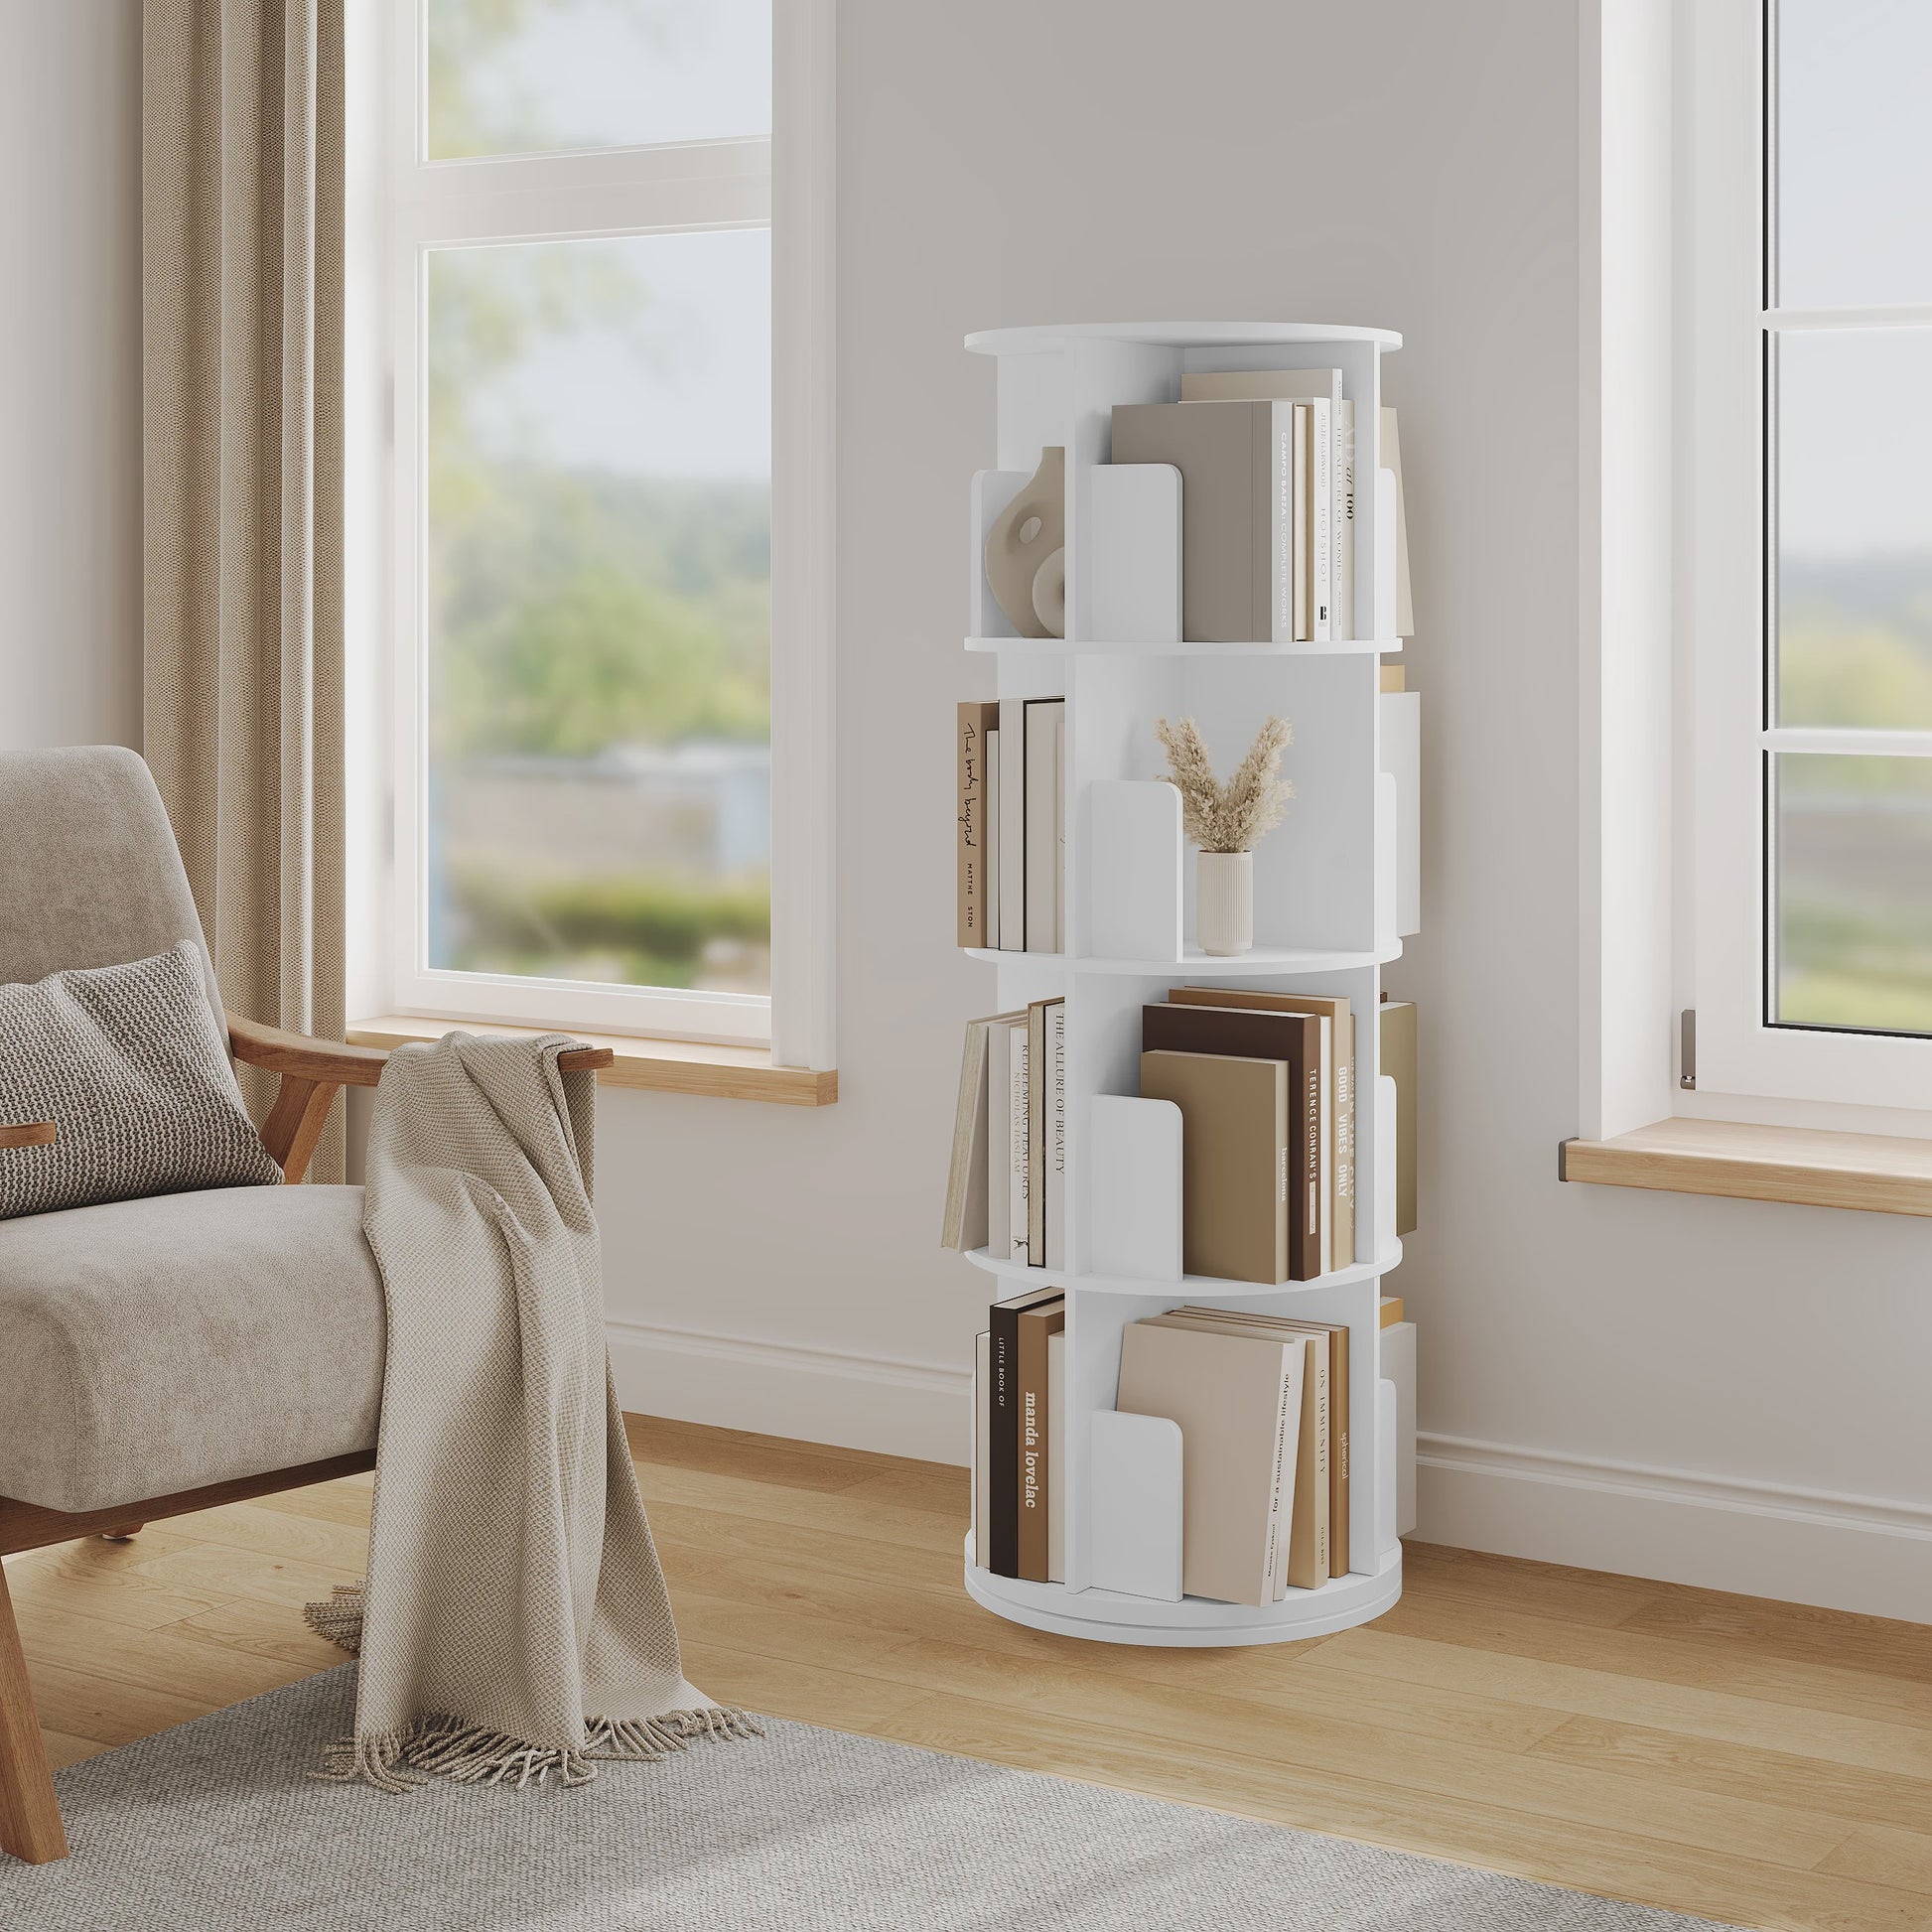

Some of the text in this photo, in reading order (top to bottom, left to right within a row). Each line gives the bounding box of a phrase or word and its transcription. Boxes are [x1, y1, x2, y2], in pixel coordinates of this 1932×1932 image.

[964, 723, 976, 754] The
[1056, 1013, 1065, 1174] THE ALLURE OF BEAUTY
[1338, 1066, 1348, 1197] GOOD VIBES ONLY
[998, 1395, 1004, 1407] OF
[1025, 1391, 1039, 1509] manda lovelac
[1276, 1419, 1285, 1484] sustainable
[1281, 1373, 1289, 1417] lifestyle
[1340, 1431, 1349, 1479] spherical
